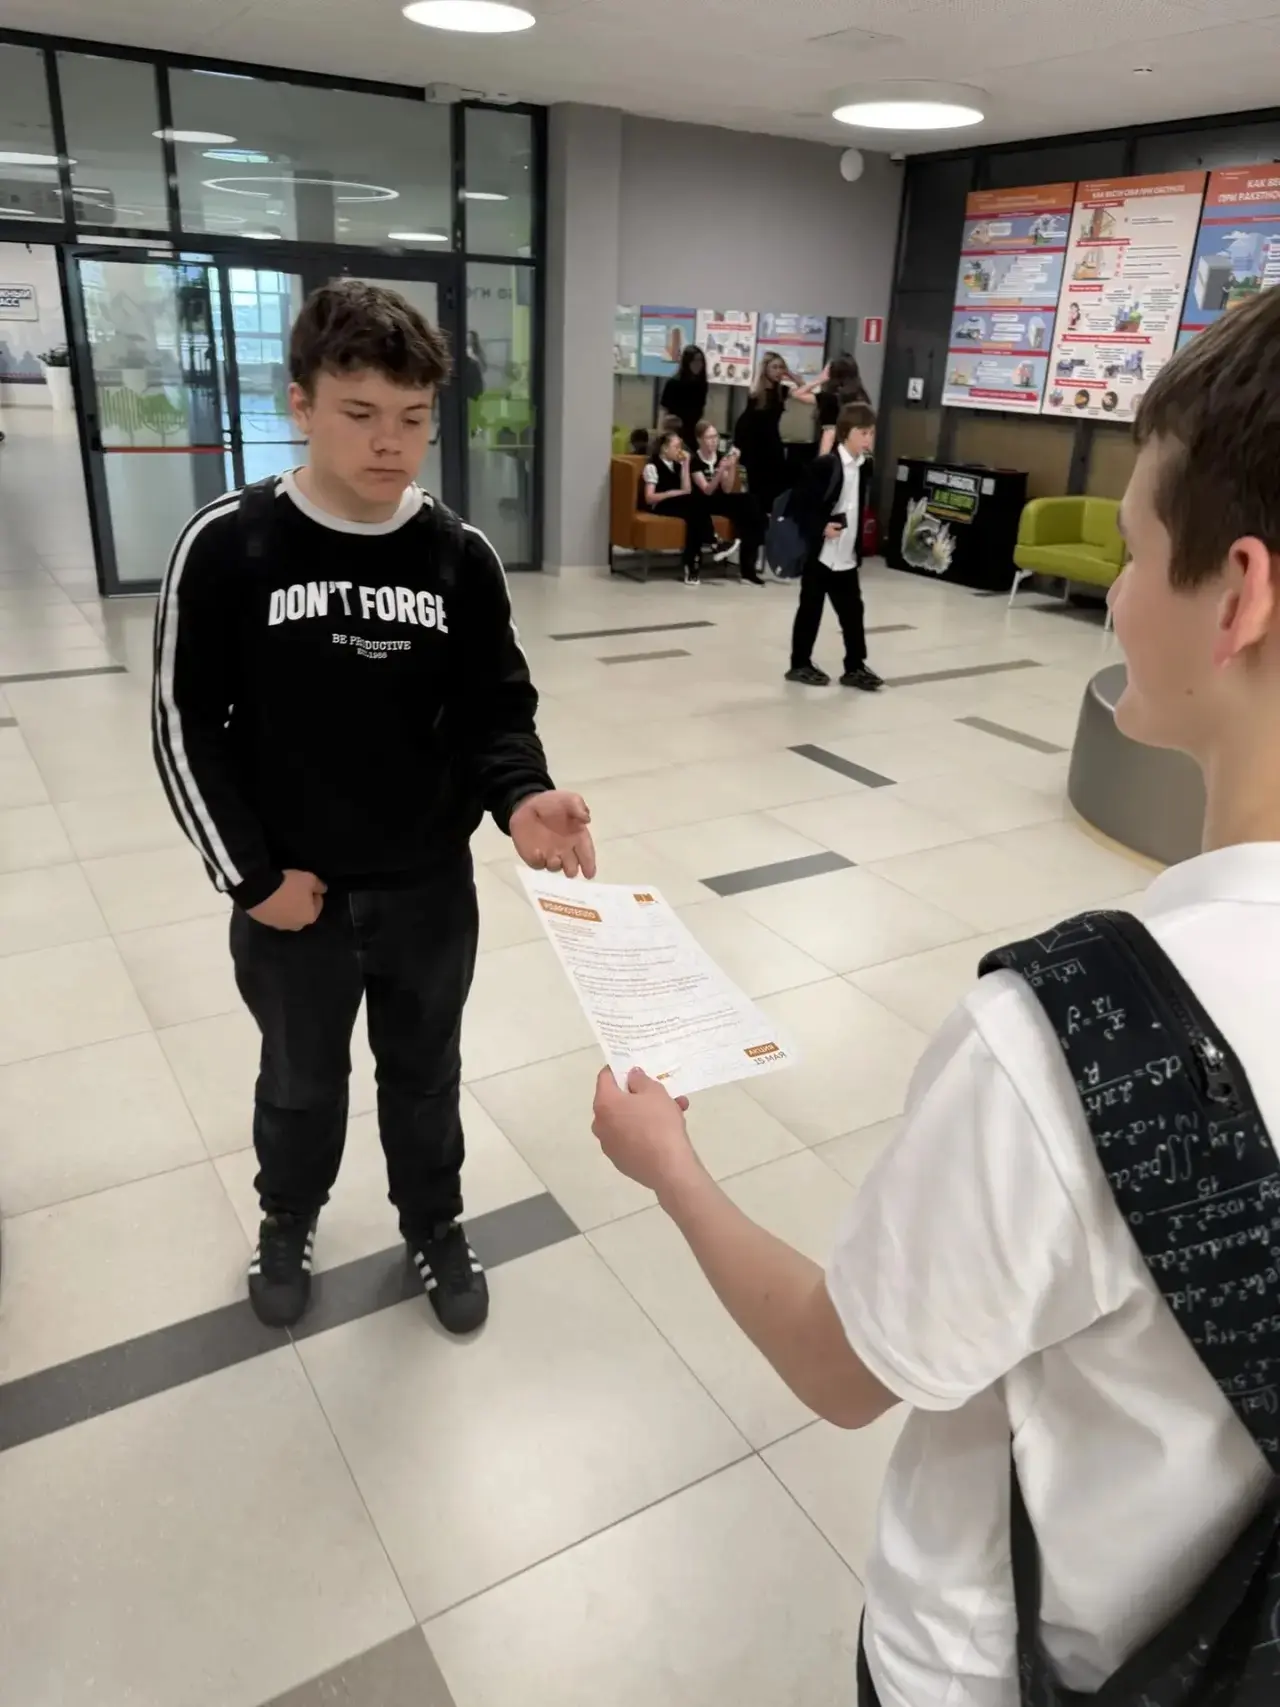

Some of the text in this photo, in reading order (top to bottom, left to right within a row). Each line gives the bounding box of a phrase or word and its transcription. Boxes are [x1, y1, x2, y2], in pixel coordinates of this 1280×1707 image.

[268, 580, 449, 634] DON'T FORGE
[332, 633, 348, 645] BE
